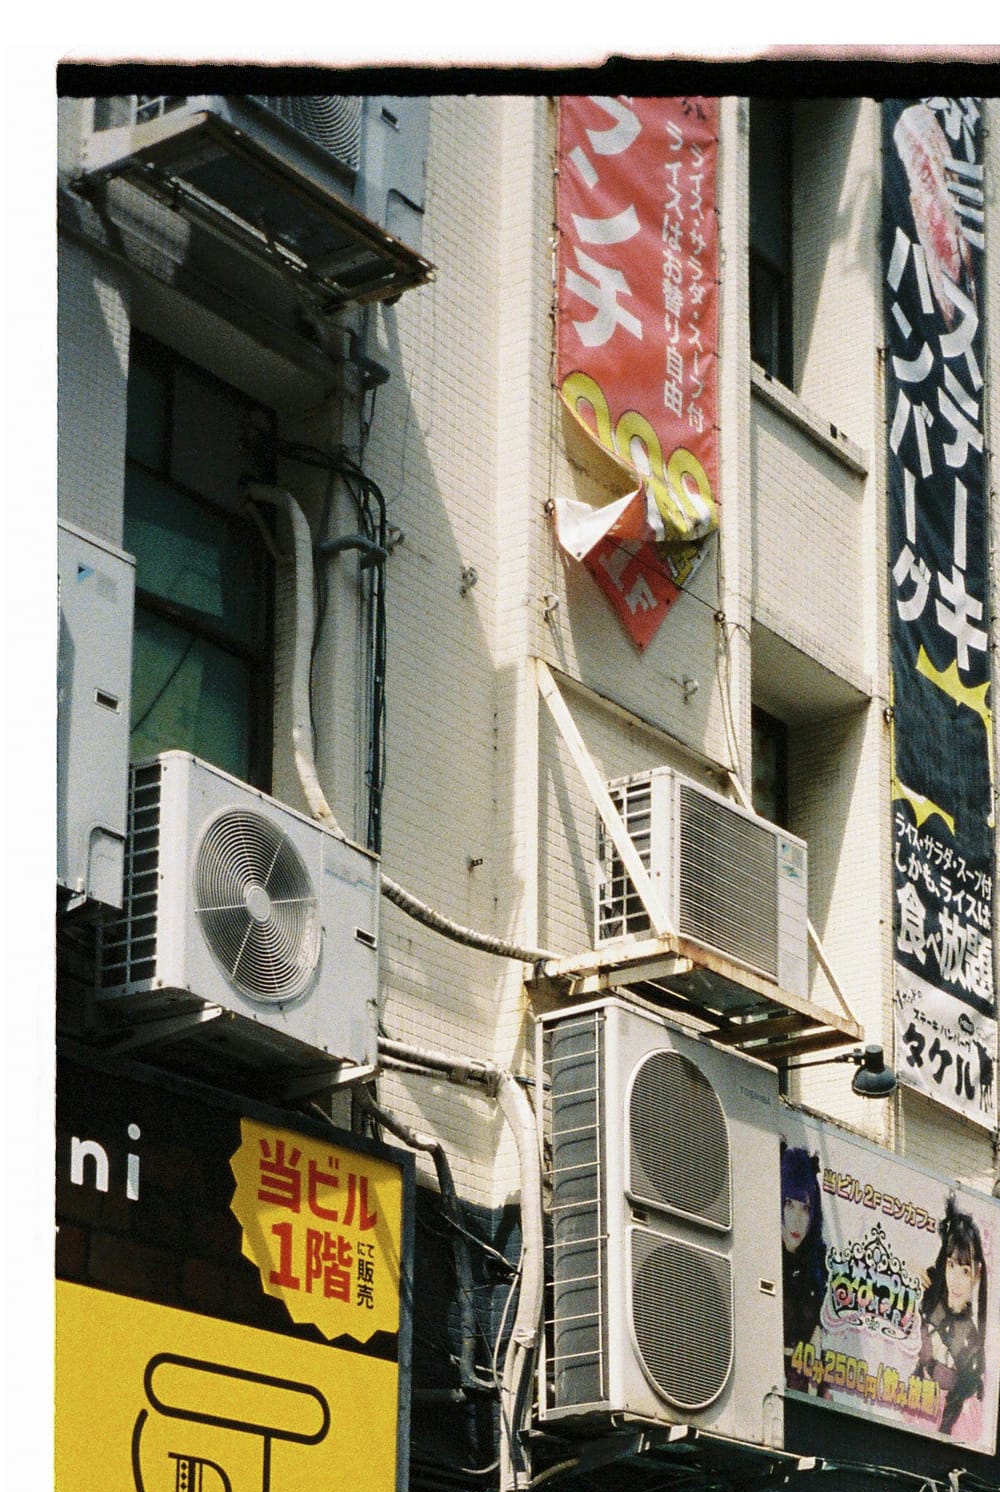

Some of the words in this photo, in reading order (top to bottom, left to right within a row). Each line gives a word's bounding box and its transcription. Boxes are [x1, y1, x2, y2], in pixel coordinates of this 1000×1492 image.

[886, 226, 934, 622] ハンバーグ
[896, 881, 993, 1006] 食べ放題
[903, 1022, 975, 1100] タケル
[257, 1138, 378, 1231] 当ビル
[269, 1222, 354, 1304] 1階
